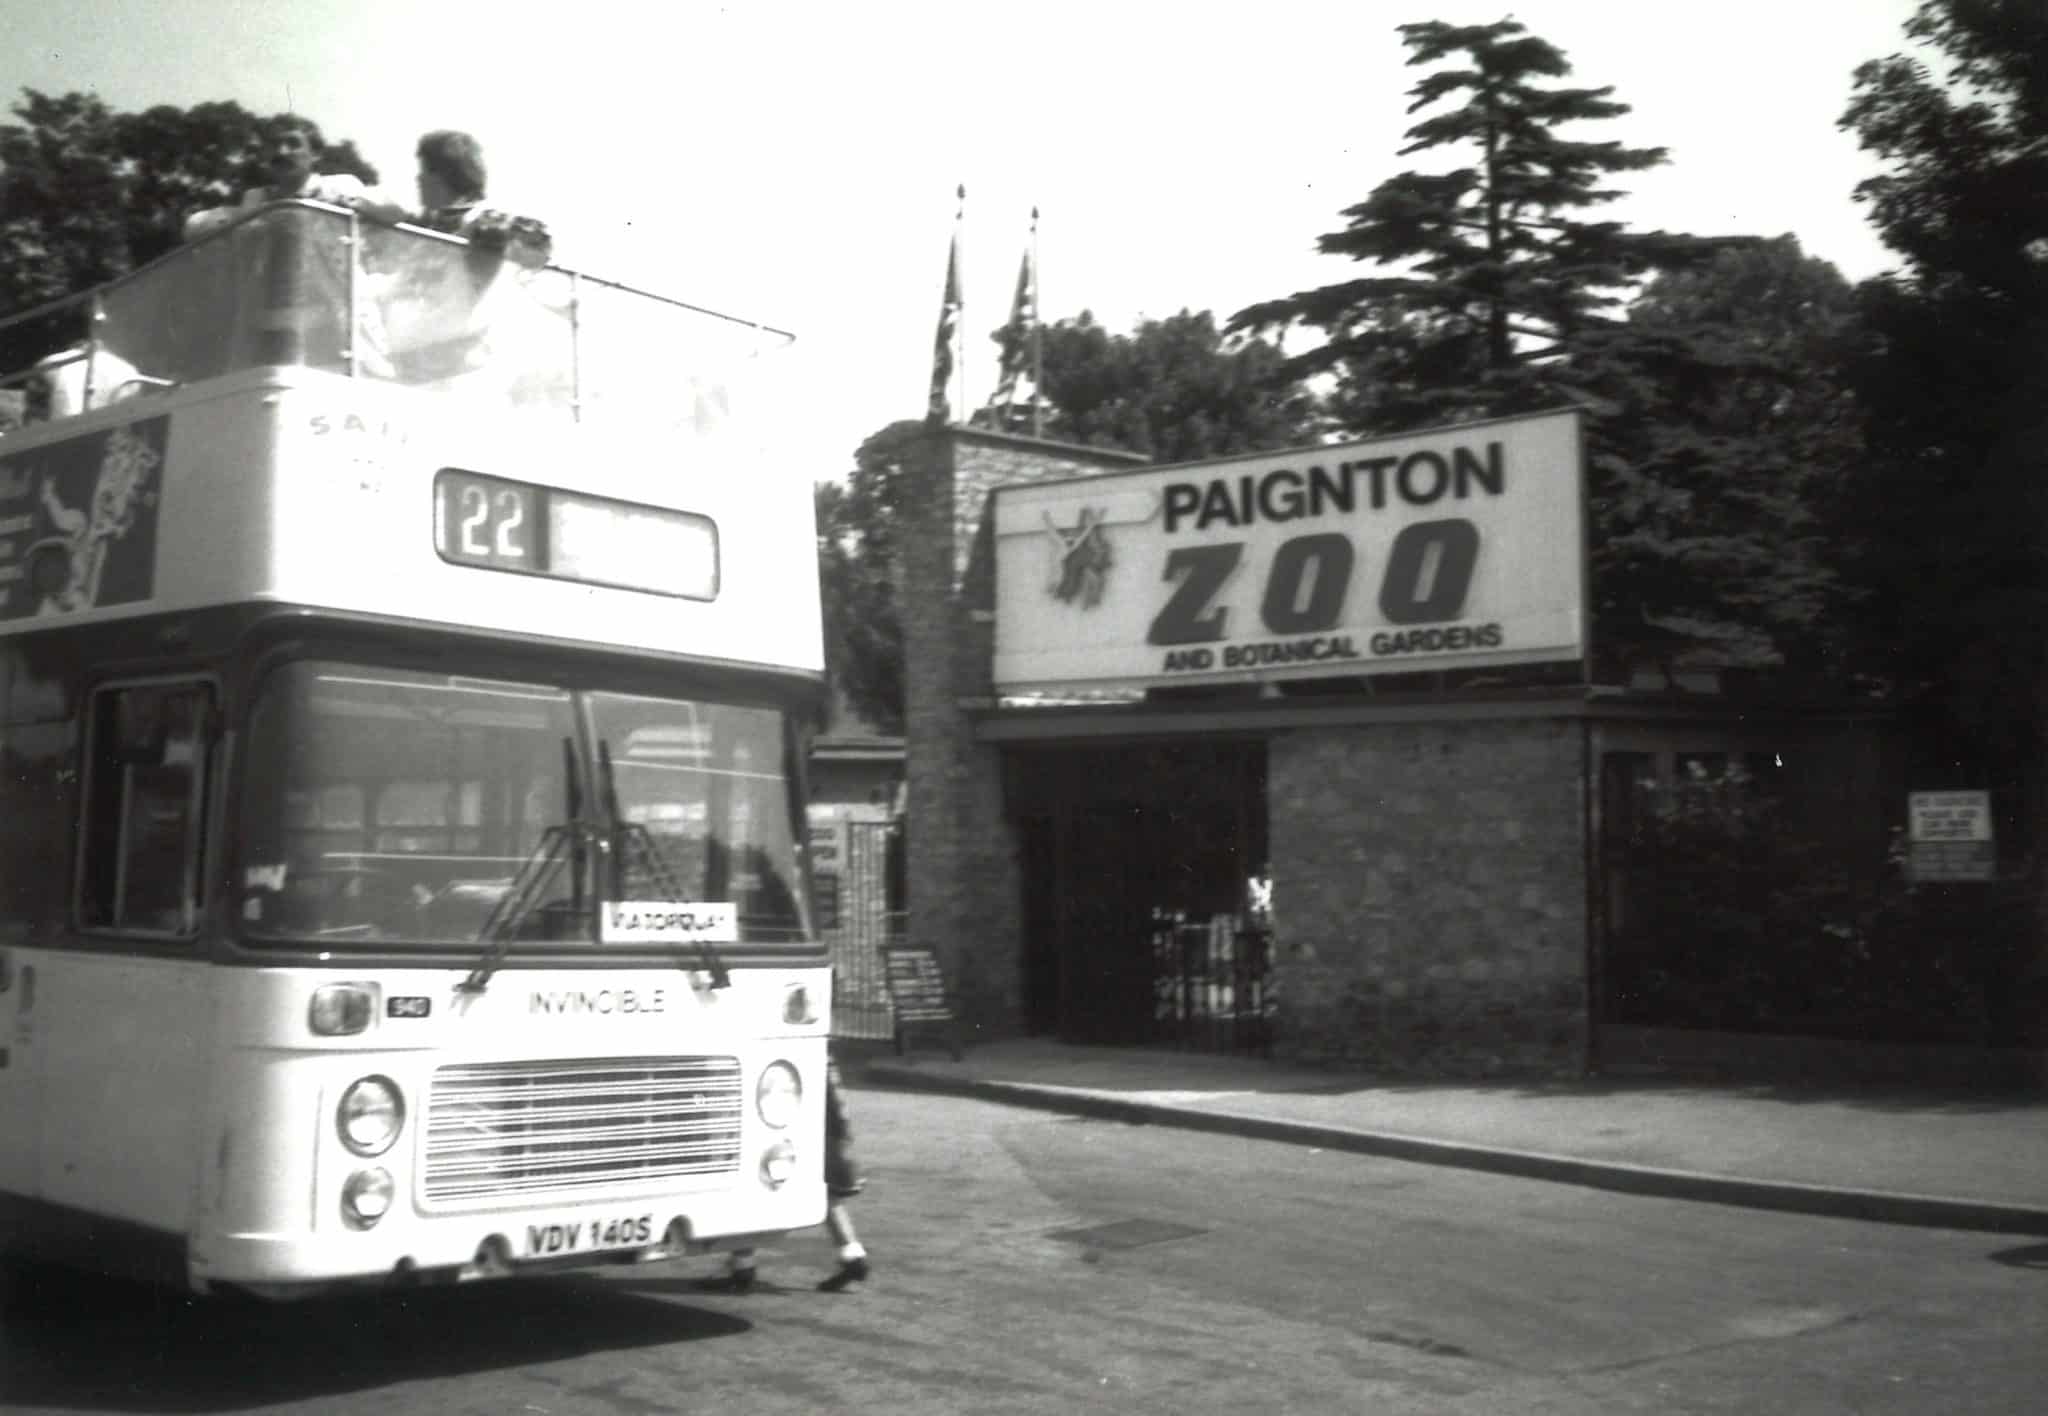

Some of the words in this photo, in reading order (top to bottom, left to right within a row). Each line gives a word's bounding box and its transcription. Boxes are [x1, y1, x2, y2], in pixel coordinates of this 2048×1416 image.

[1162, 441, 1506, 533] PAIGNTON
[462, 485, 524, 556] 22
[1146, 517, 1481, 646] ZOO
[1163, 650, 1214, 672] AND
[1223, 637, 1360, 669] BOTANICAL
[1370, 623, 1503, 656] GARDENS
[529, 988, 665, 1015] INVINCIBLE
[526, 1224, 581, 1254] VDV
[591, 1216, 654, 1247] 140S
